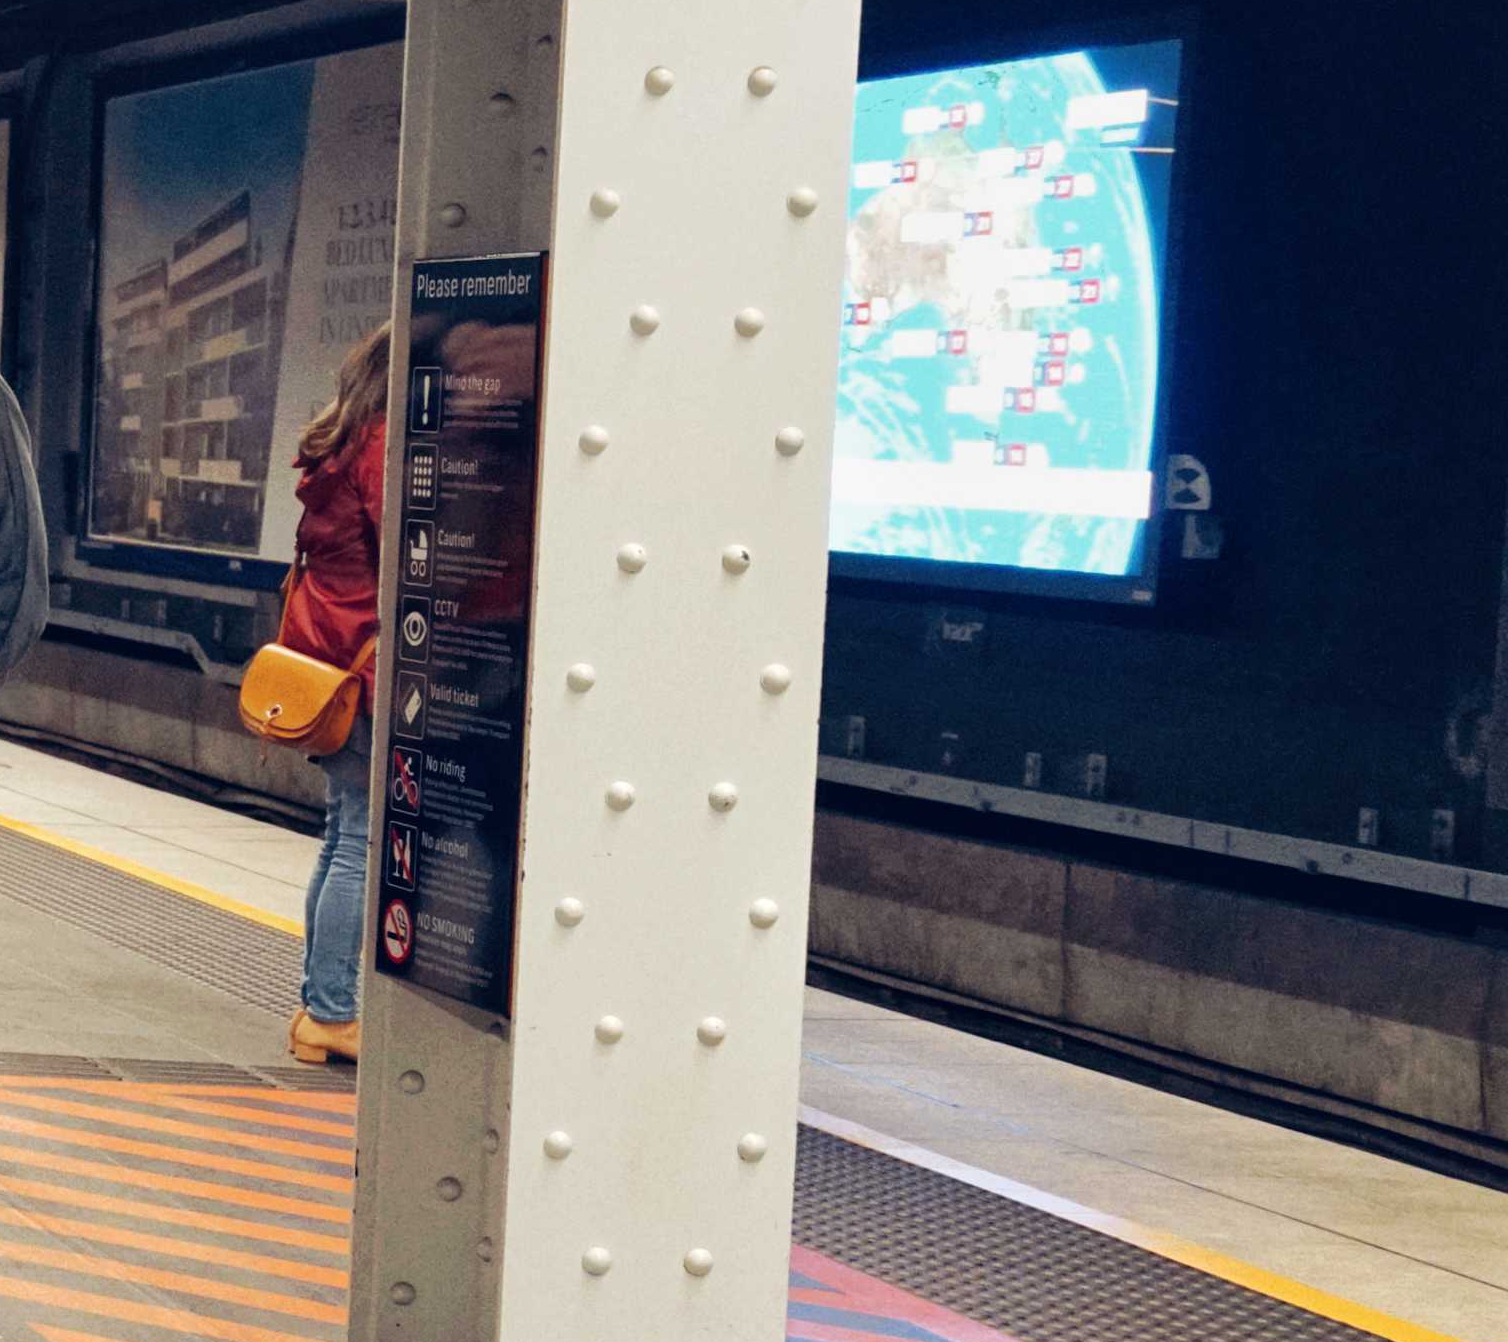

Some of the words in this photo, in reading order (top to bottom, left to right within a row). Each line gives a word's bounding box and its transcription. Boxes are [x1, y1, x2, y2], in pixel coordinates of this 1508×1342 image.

[417, 273, 458, 299] Please
[460, 268, 532, 297] remember
[444, 374, 466, 392] Mind
[468, 375, 483, 392] the
[483, 378, 501, 396] gap
[441, 457, 478, 475] Caution!
[437, 529, 475, 548] Caution!
[434, 599, 460, 618] CCTV
[430, 682, 452, 702] Valid
[453, 687, 480, 708] ticket
[426, 754, 439, 772] No
[440, 759, 467, 783] riding
[422, 830, 434, 849] No
[435, 836, 469, 861] alcohol
[416, 911, 430, 930] NO
[432, 916, 475, 945] SMOKING
